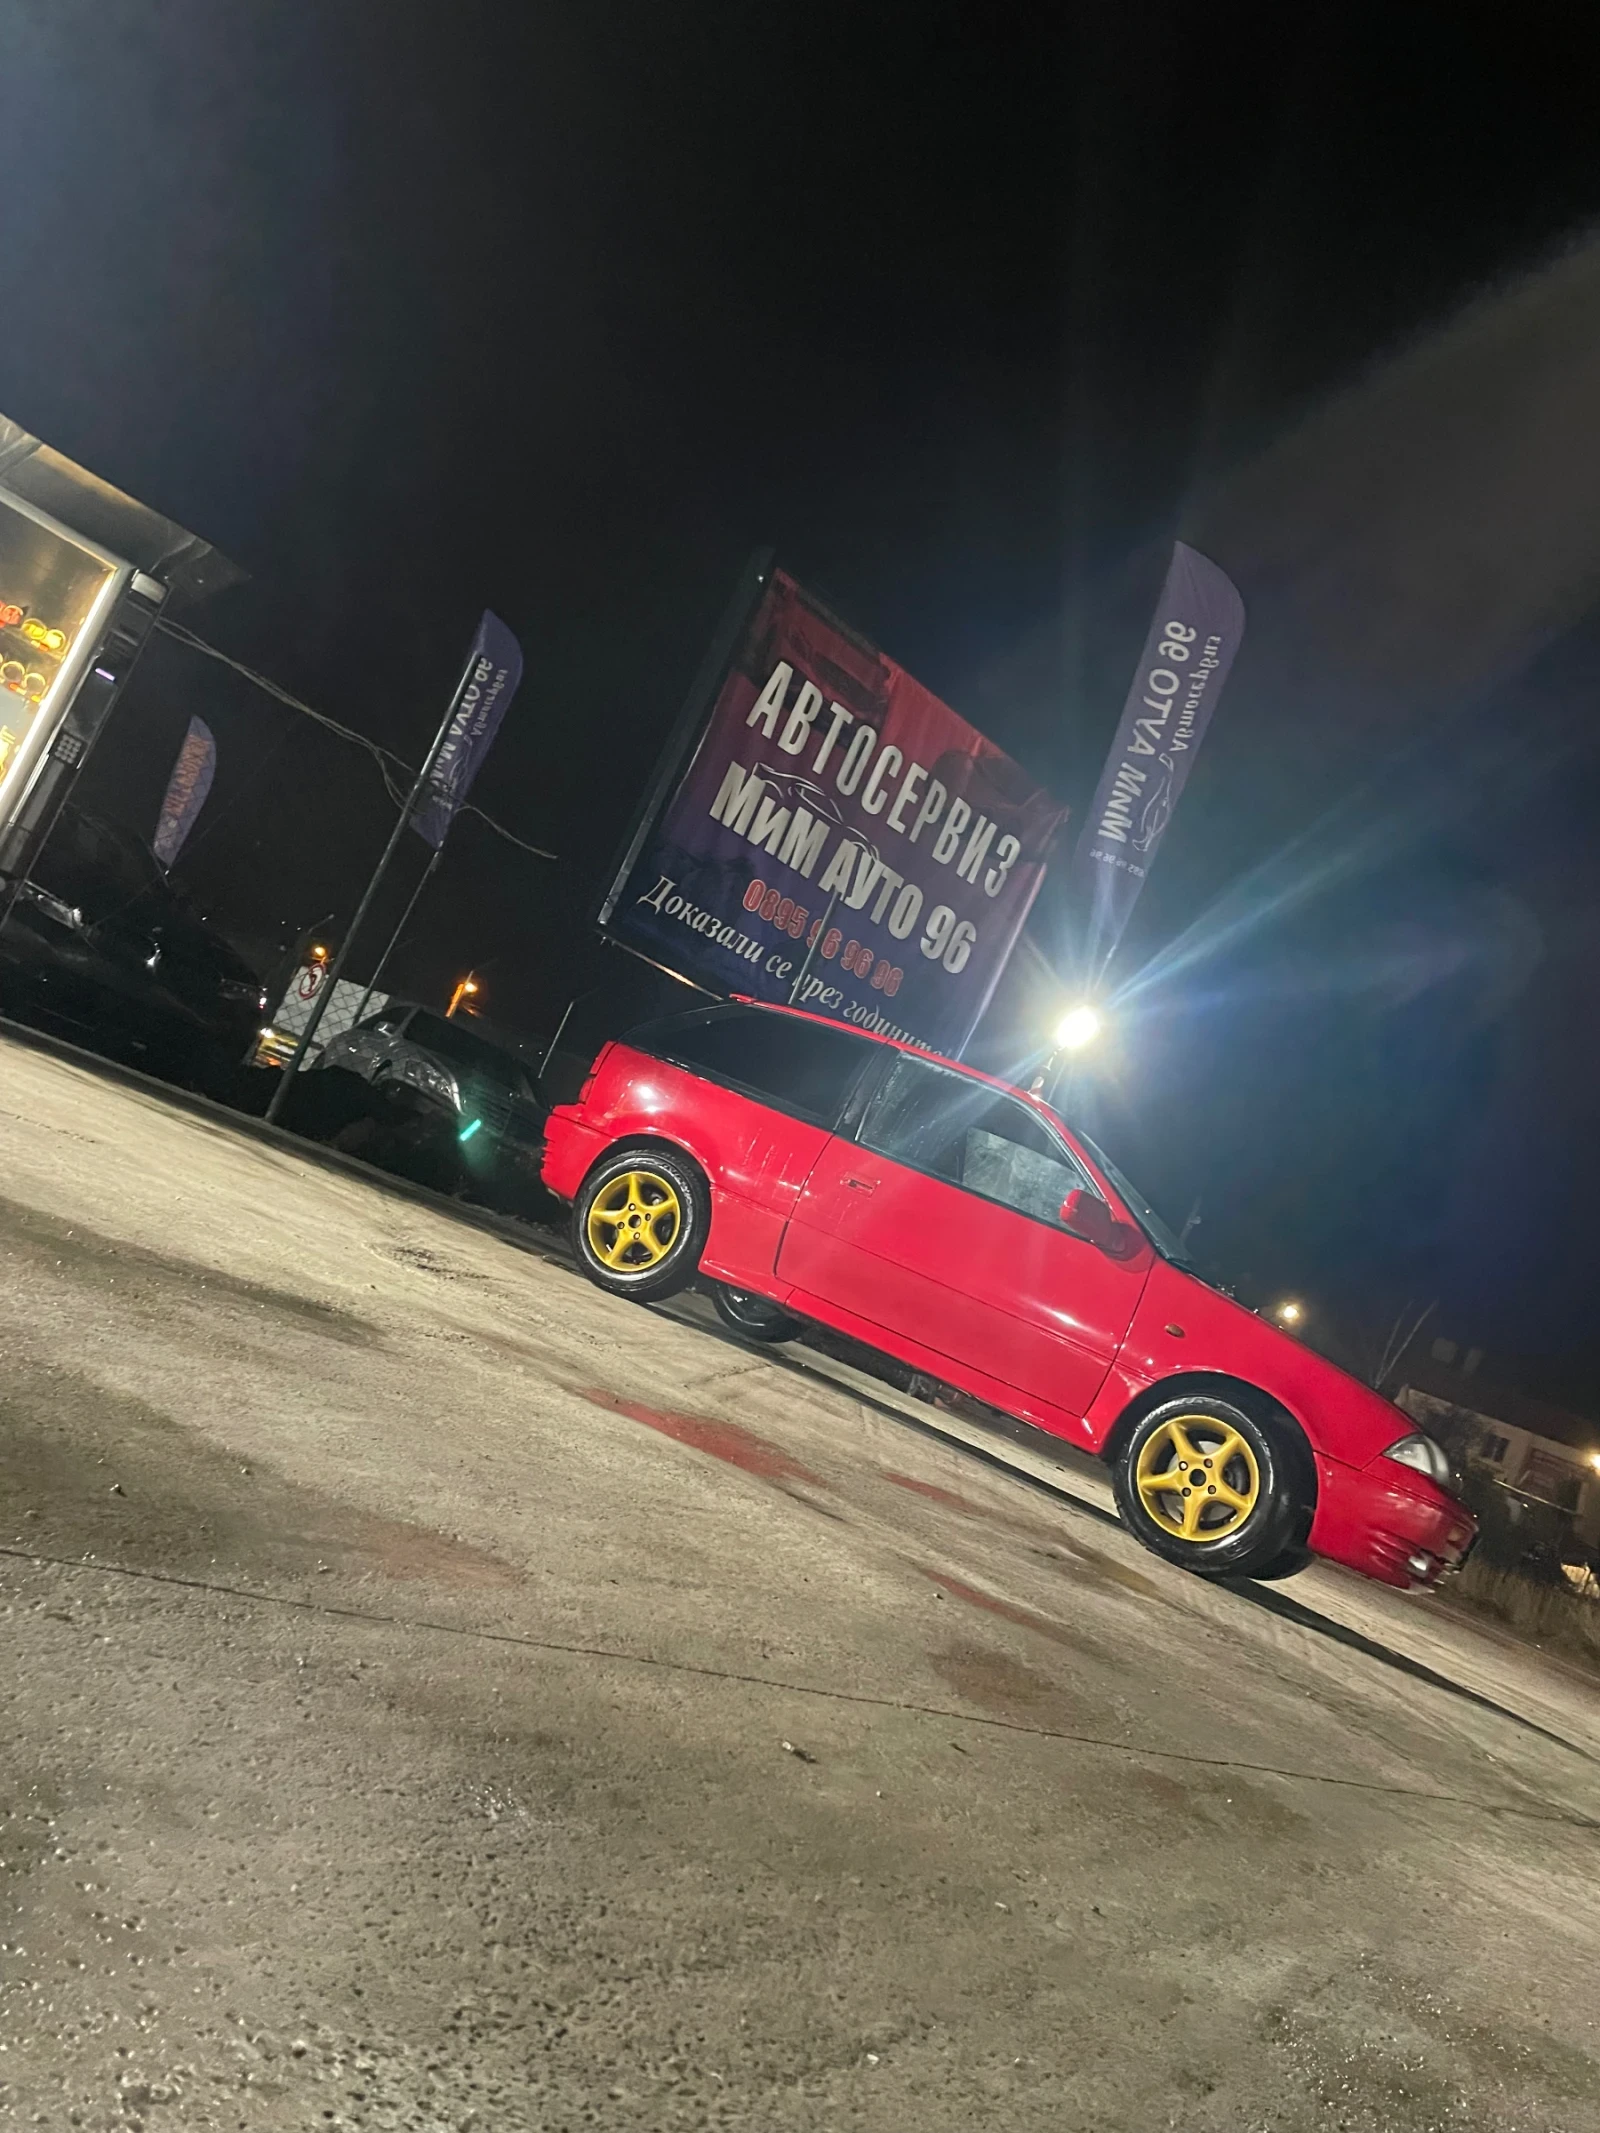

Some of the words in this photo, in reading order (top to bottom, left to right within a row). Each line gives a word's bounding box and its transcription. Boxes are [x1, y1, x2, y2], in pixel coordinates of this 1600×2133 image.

[746, 660, 1021, 898] АВТОСЕРВИЗ
[636, 875, 765, 963] Доказали
[765, 954, 793, 979] се
[709, 761, 831, 879] МиМ
[818, 838, 924, 941] АУТО
[919, 904, 978, 975] 96
[742, 879, 810, 939] 0895
[840, 939, 875, 979] 96
[869, 959, 905, 997] 96
